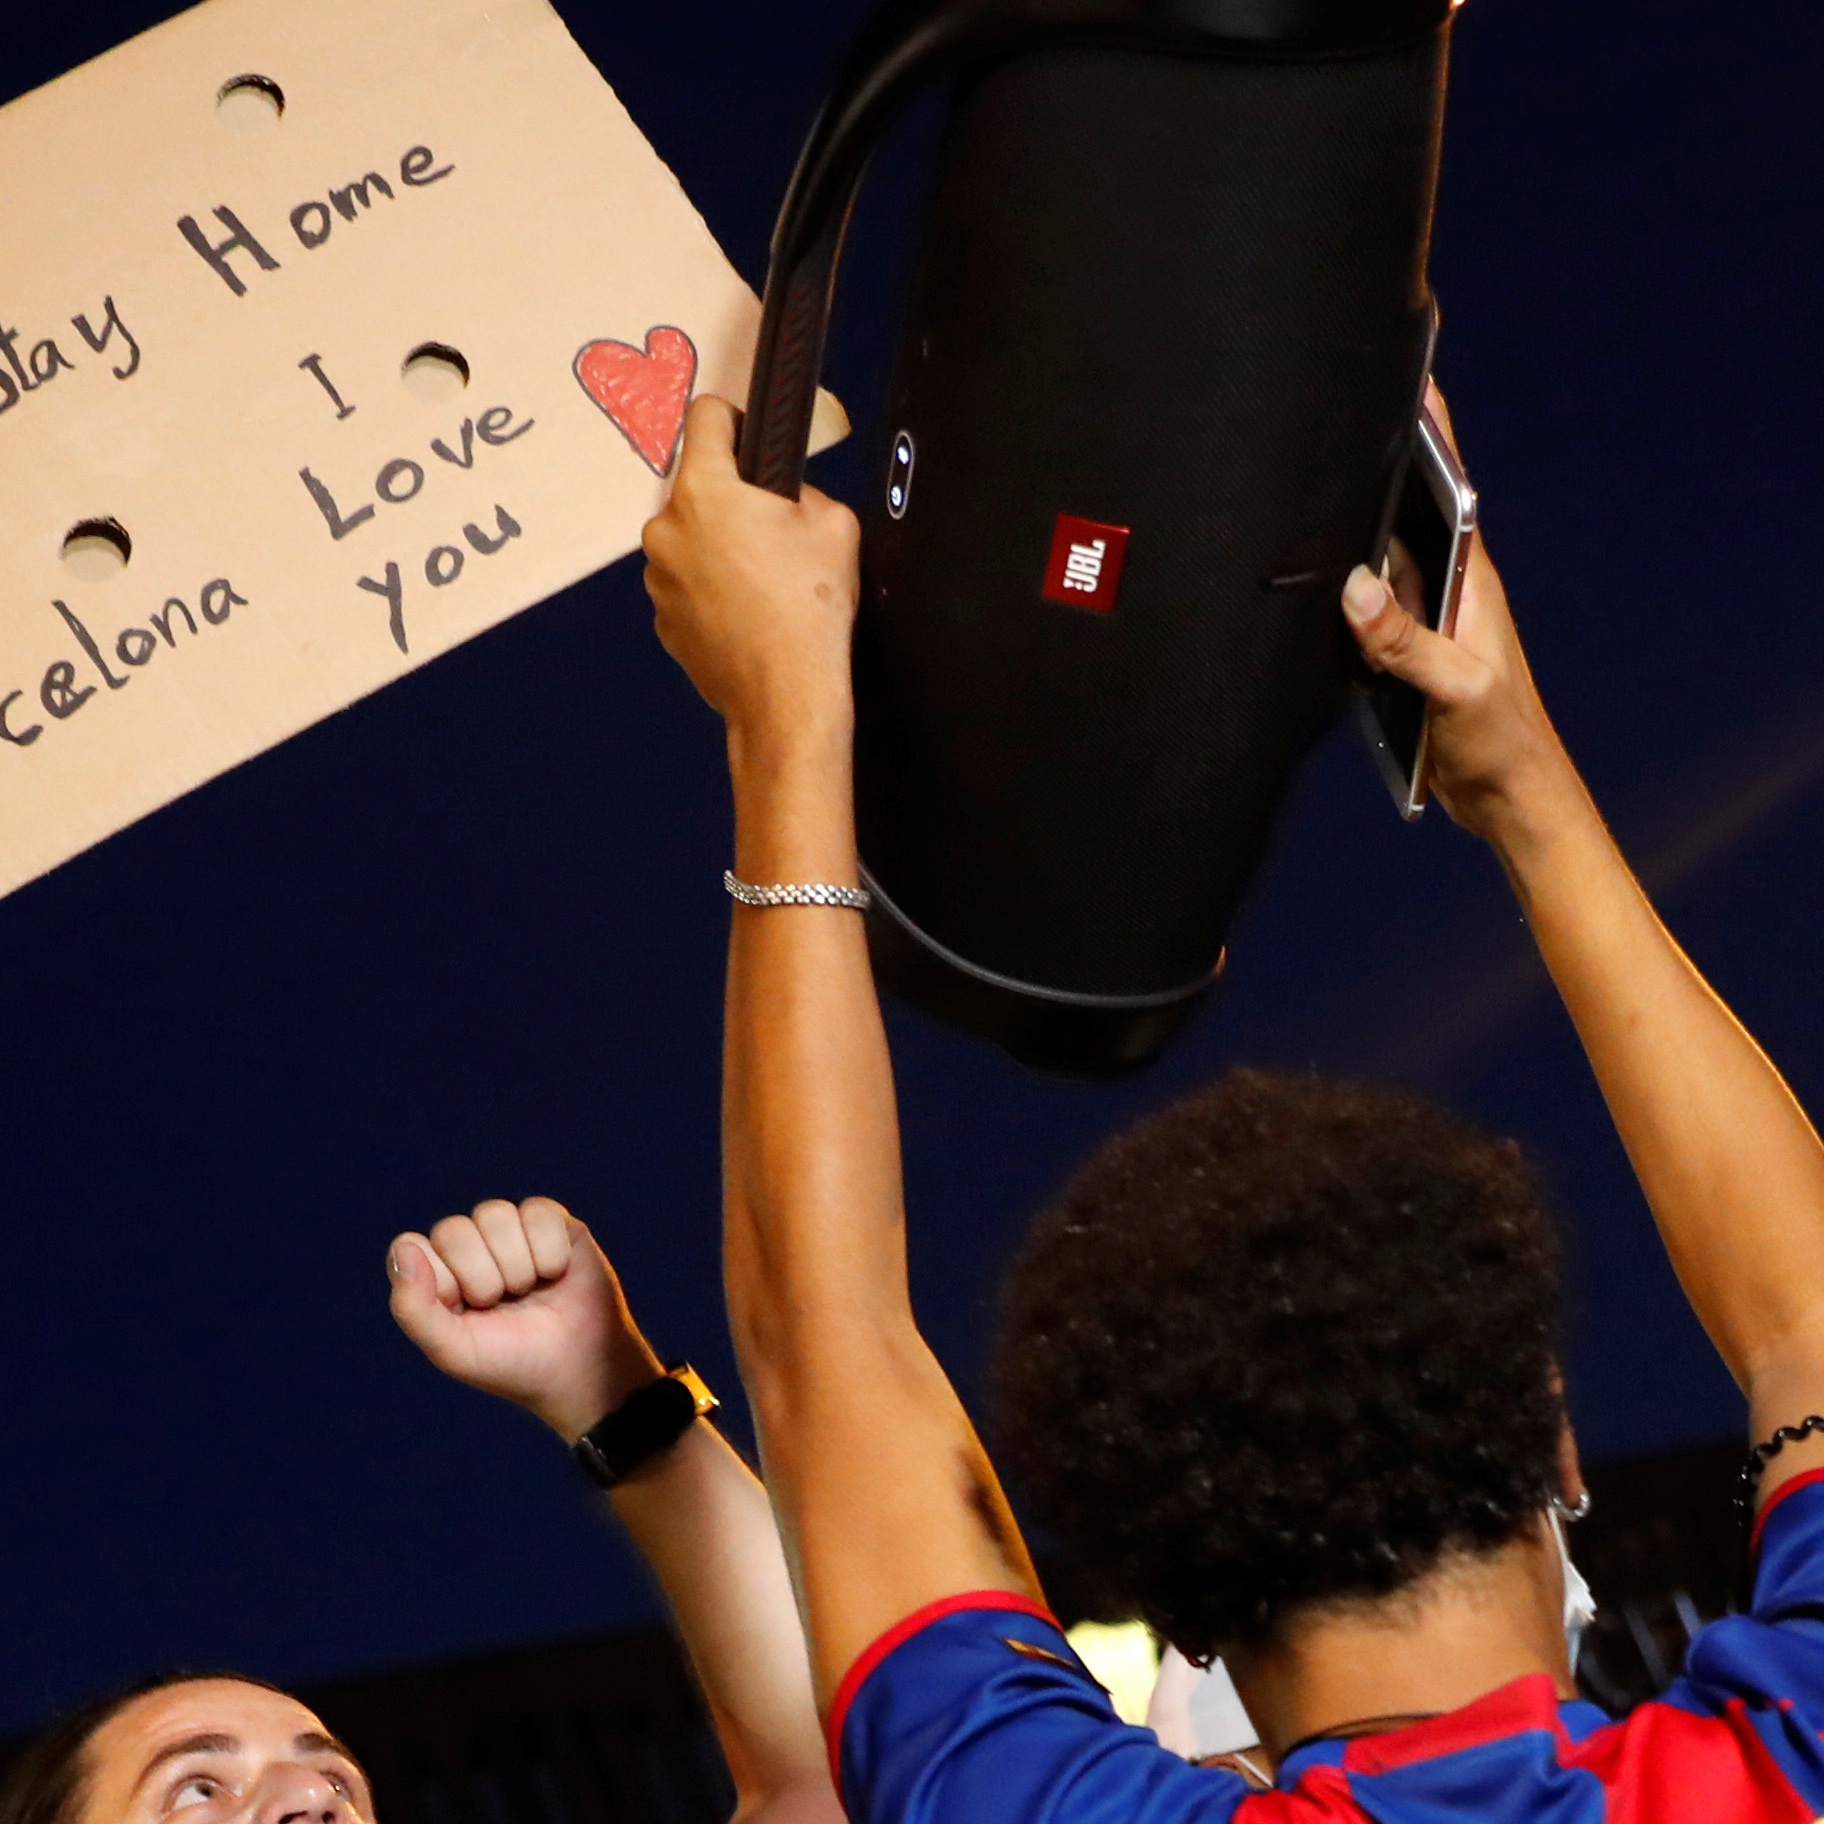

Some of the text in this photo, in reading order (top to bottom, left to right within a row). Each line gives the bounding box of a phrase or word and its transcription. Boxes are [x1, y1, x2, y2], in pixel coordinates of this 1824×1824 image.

[178, 144, 455, 296] Home
[299, 354, 356, 420] I
[299, 405, 534, 541] Love
[1062, 538, 1107, 593] JBL
